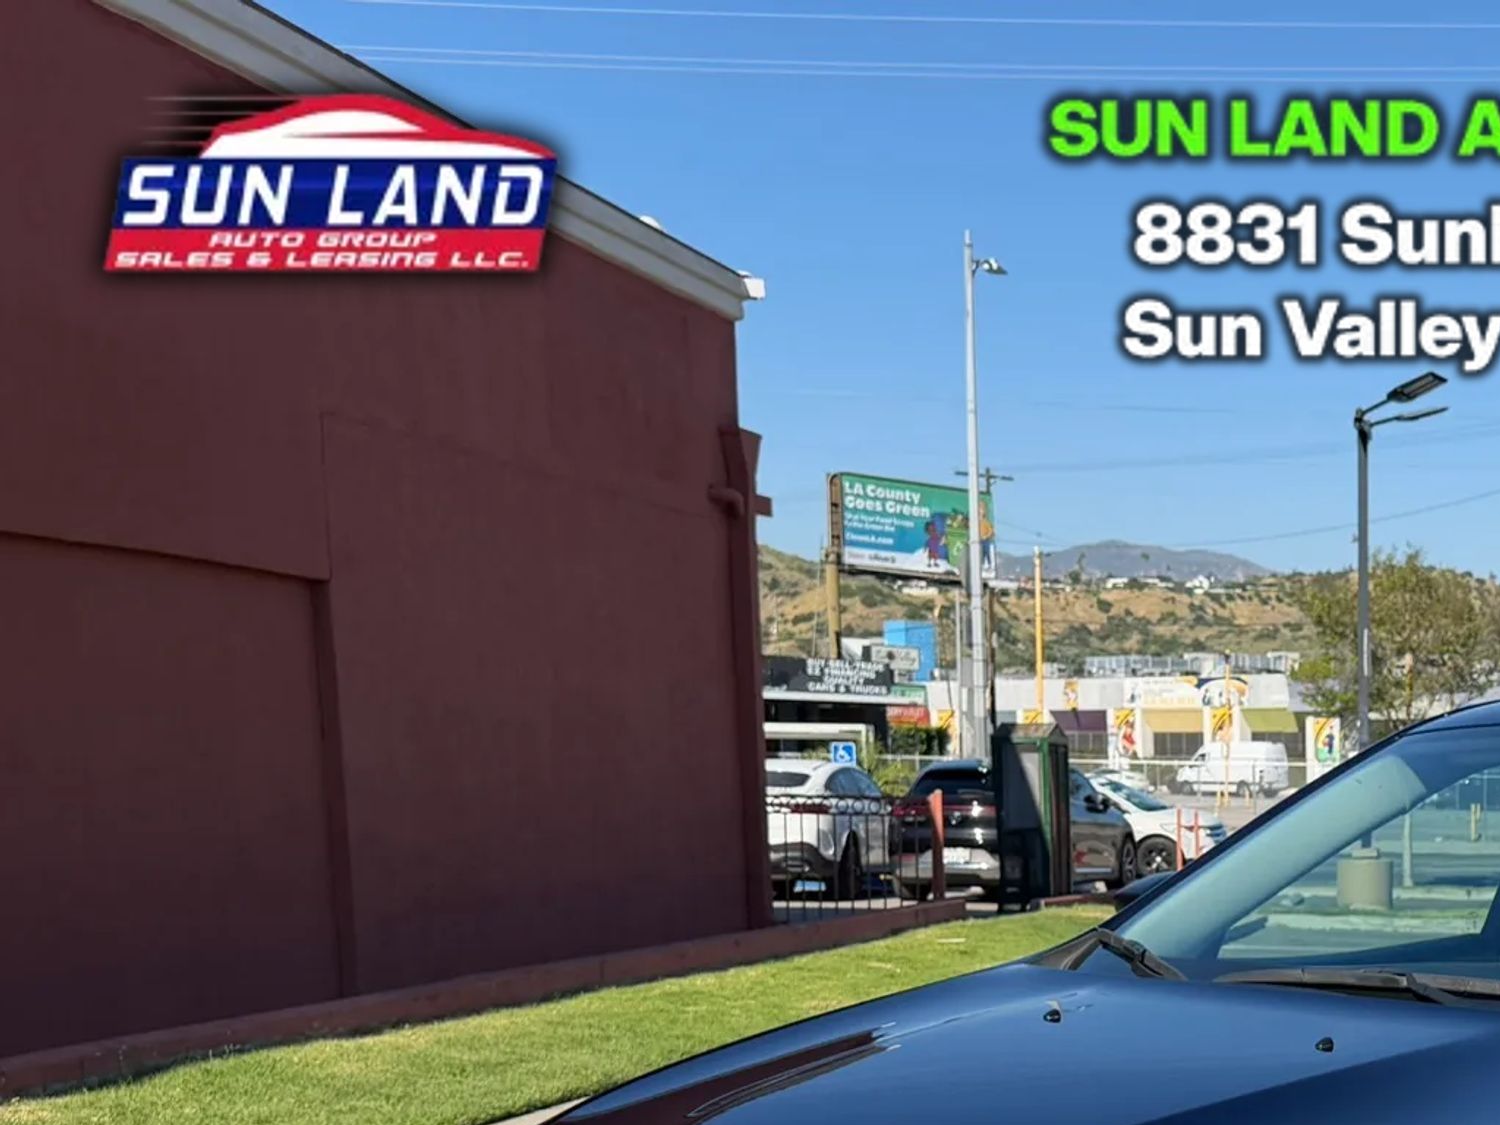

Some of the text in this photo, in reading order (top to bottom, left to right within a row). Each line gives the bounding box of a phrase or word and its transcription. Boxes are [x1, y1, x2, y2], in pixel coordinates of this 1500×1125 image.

[844, 481, 921, 505] LA County
[845, 496, 931, 518] Goes Green
